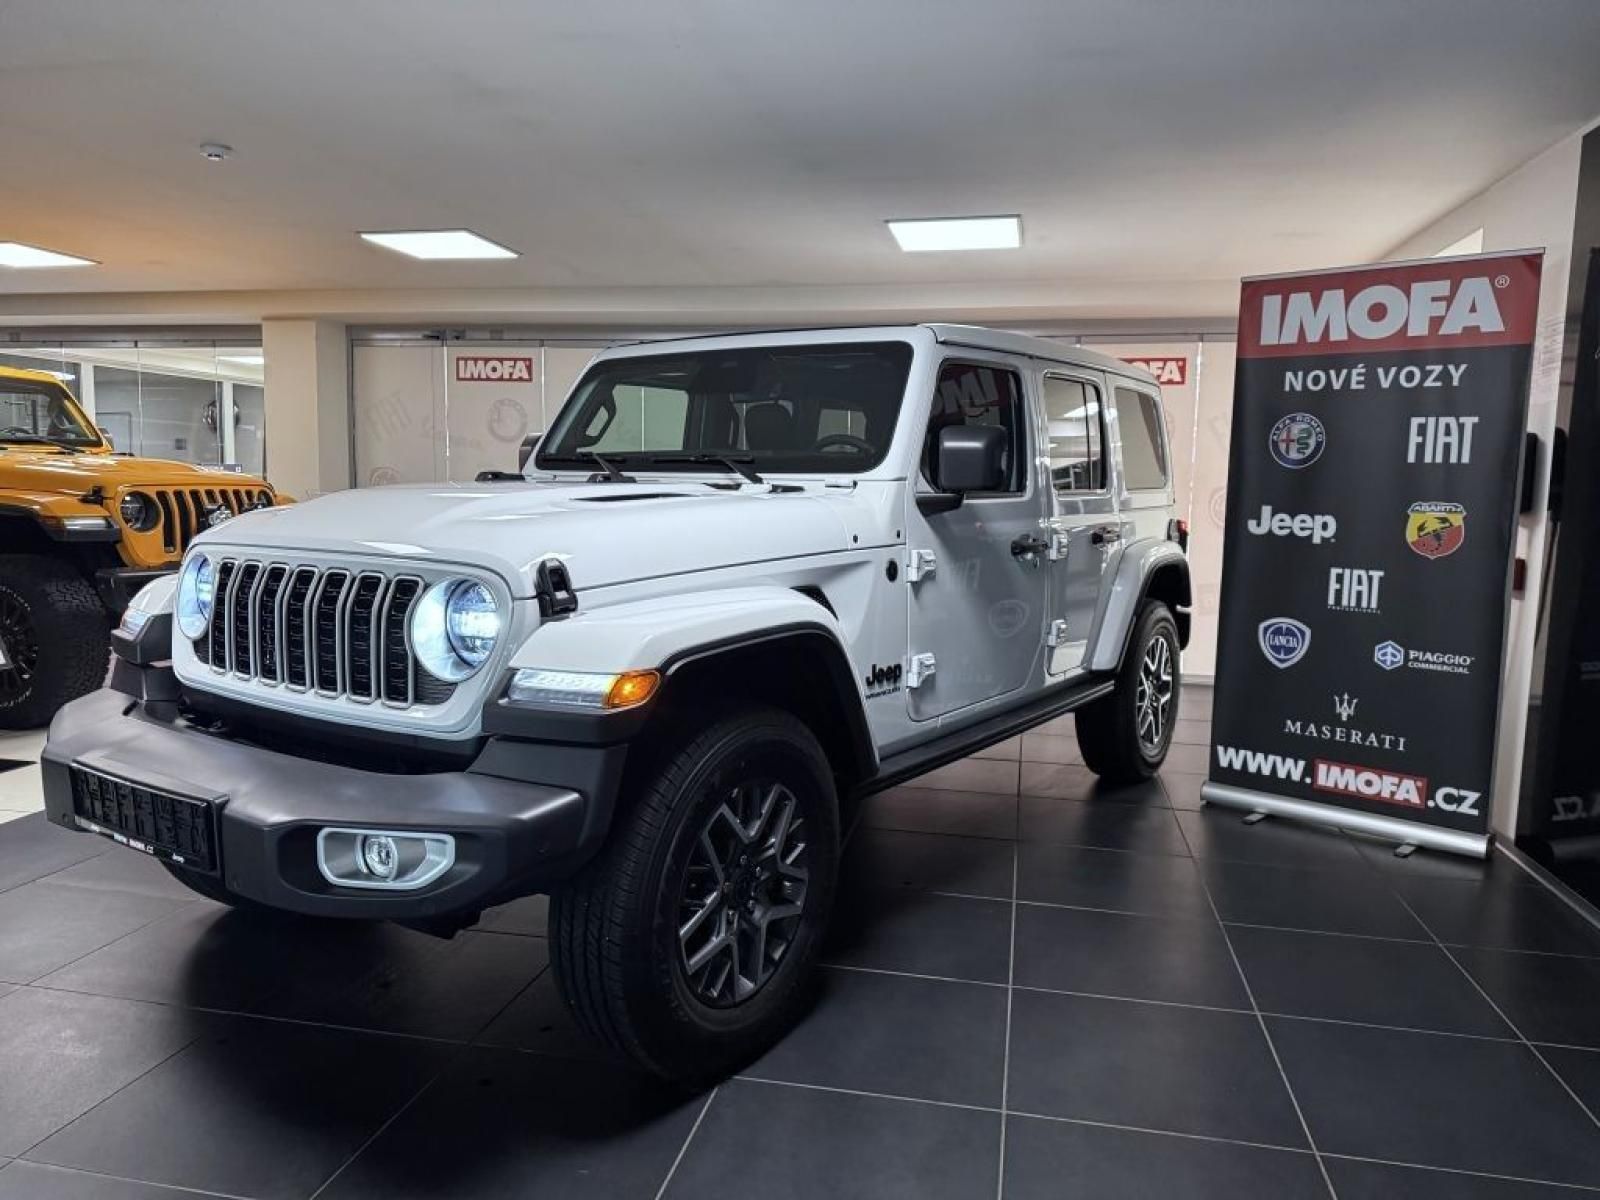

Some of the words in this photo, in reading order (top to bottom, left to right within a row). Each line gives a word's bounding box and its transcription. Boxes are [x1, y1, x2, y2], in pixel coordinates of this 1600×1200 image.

[458, 360, 529, 379] IMOFA
[1284, 364, 1366, 392] NOVÉ
[1377, 363, 1468, 389] VOZY
[1407, 416, 1479, 464] FIAT
[1247, 505, 1336, 544] Jeep
[1328, 567, 1384, 609] FIAT
[1407, 660, 1470, 675] COMMERCIAL
[1408, 649, 1471, 666] PIAGGIO
[865, 663, 902, 687] Jeep
[1283, 719, 1407, 751] MASERATI
